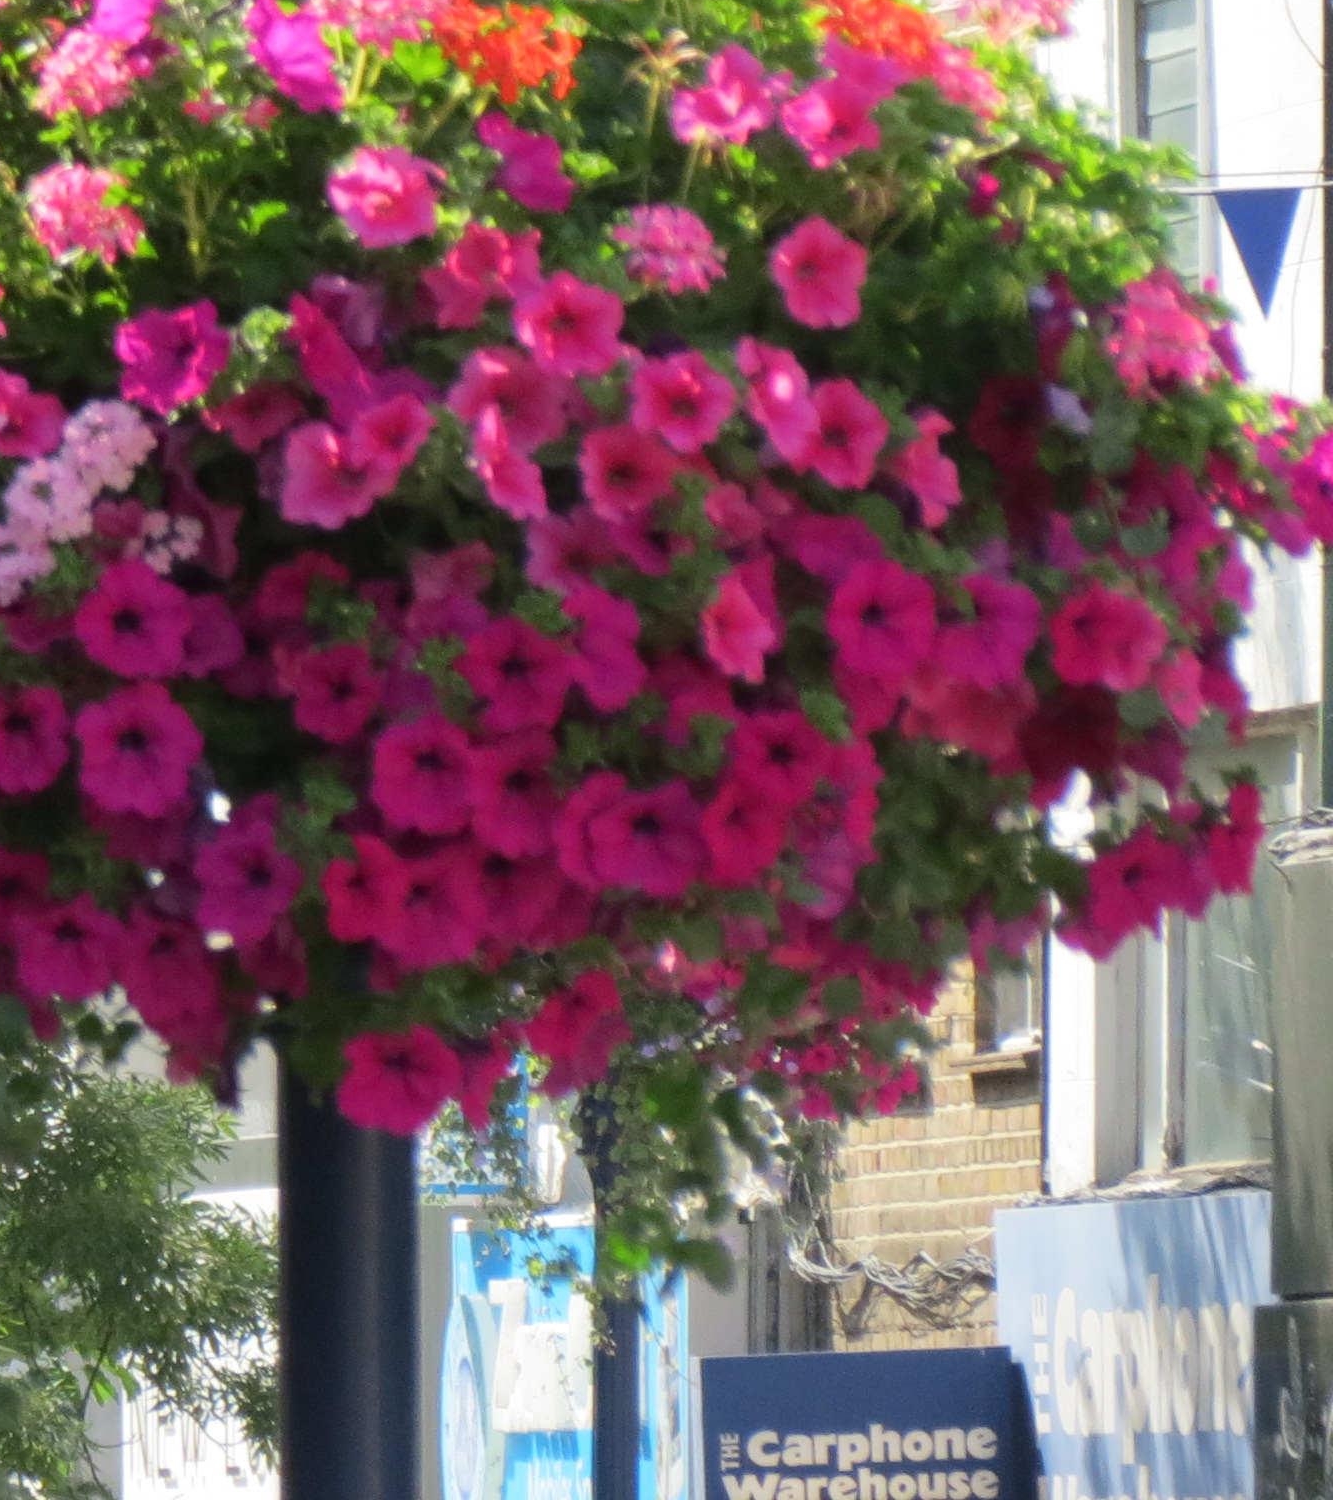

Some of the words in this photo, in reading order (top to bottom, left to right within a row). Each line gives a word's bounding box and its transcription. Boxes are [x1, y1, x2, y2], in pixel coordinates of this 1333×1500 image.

[1032, 1293, 1051, 1434] THE
[1053, 1273, 1254, 1465] Carphone
[720, 1432, 740, 1471] THE
[746, 1422, 998, 1472] Carphone
[721, 1467, 1000, 1500] Warehouse
